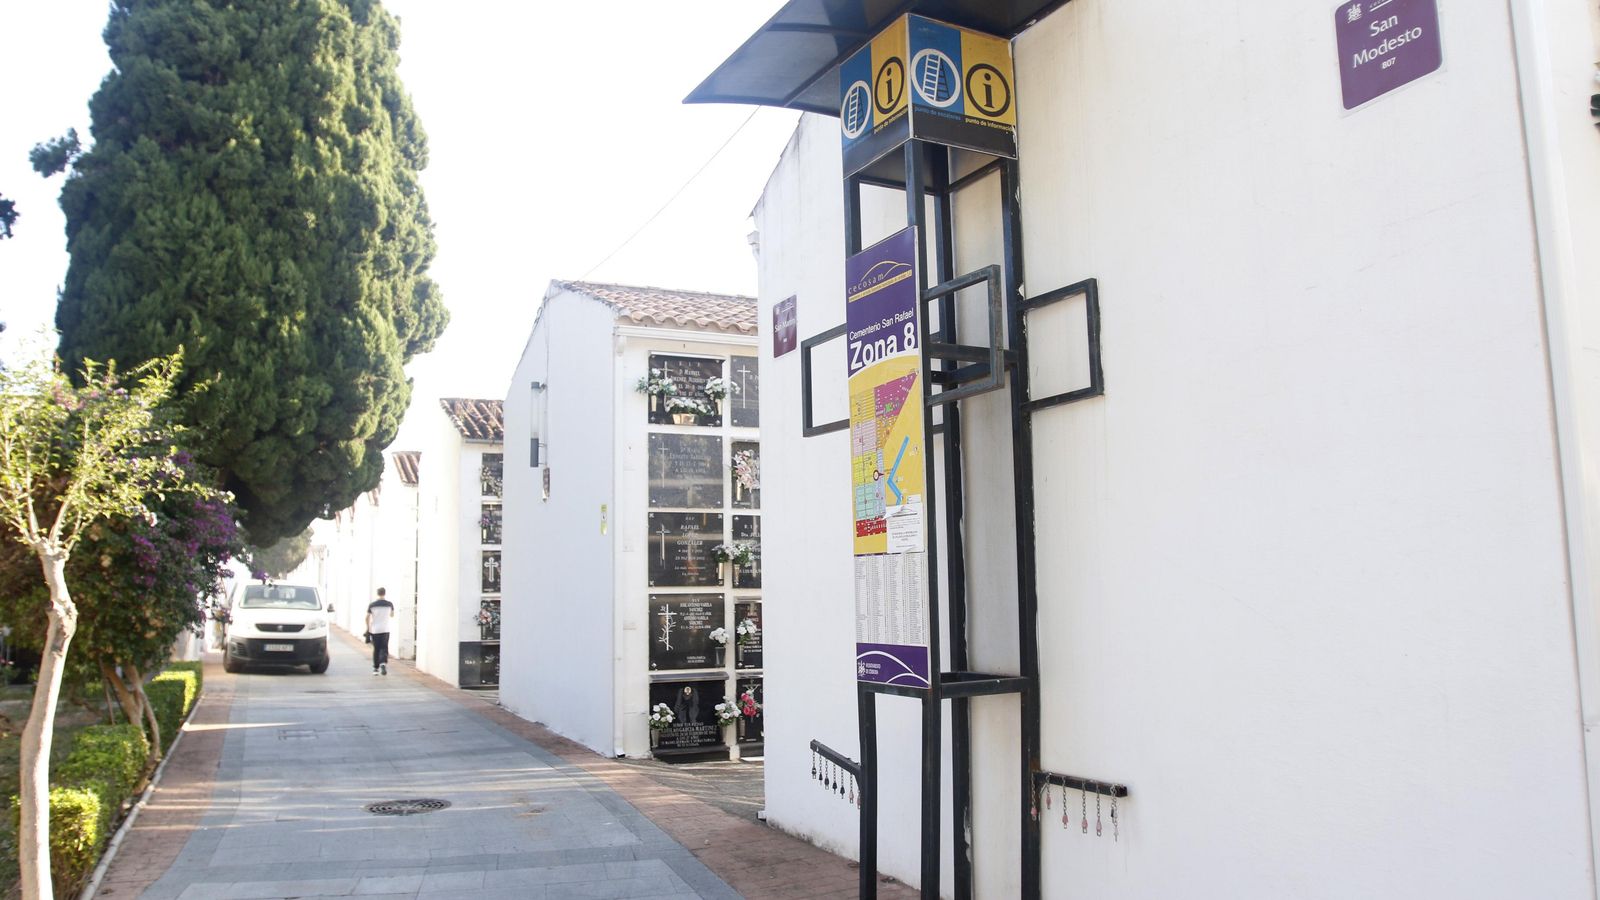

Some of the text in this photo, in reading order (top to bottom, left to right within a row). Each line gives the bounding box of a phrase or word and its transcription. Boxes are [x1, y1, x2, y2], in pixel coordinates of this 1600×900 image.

[1369, 15, 1399, 37] San
[1352, 27, 1422, 68] Modesto
[1381, 57, 1396, 69] 807
[965, 117, 980, 125] punto
[848, 272, 884, 294] cecosam
[849, 307, 914, 341] Cementerio San Rafael
[850, 321, 916, 371] Zona 8
